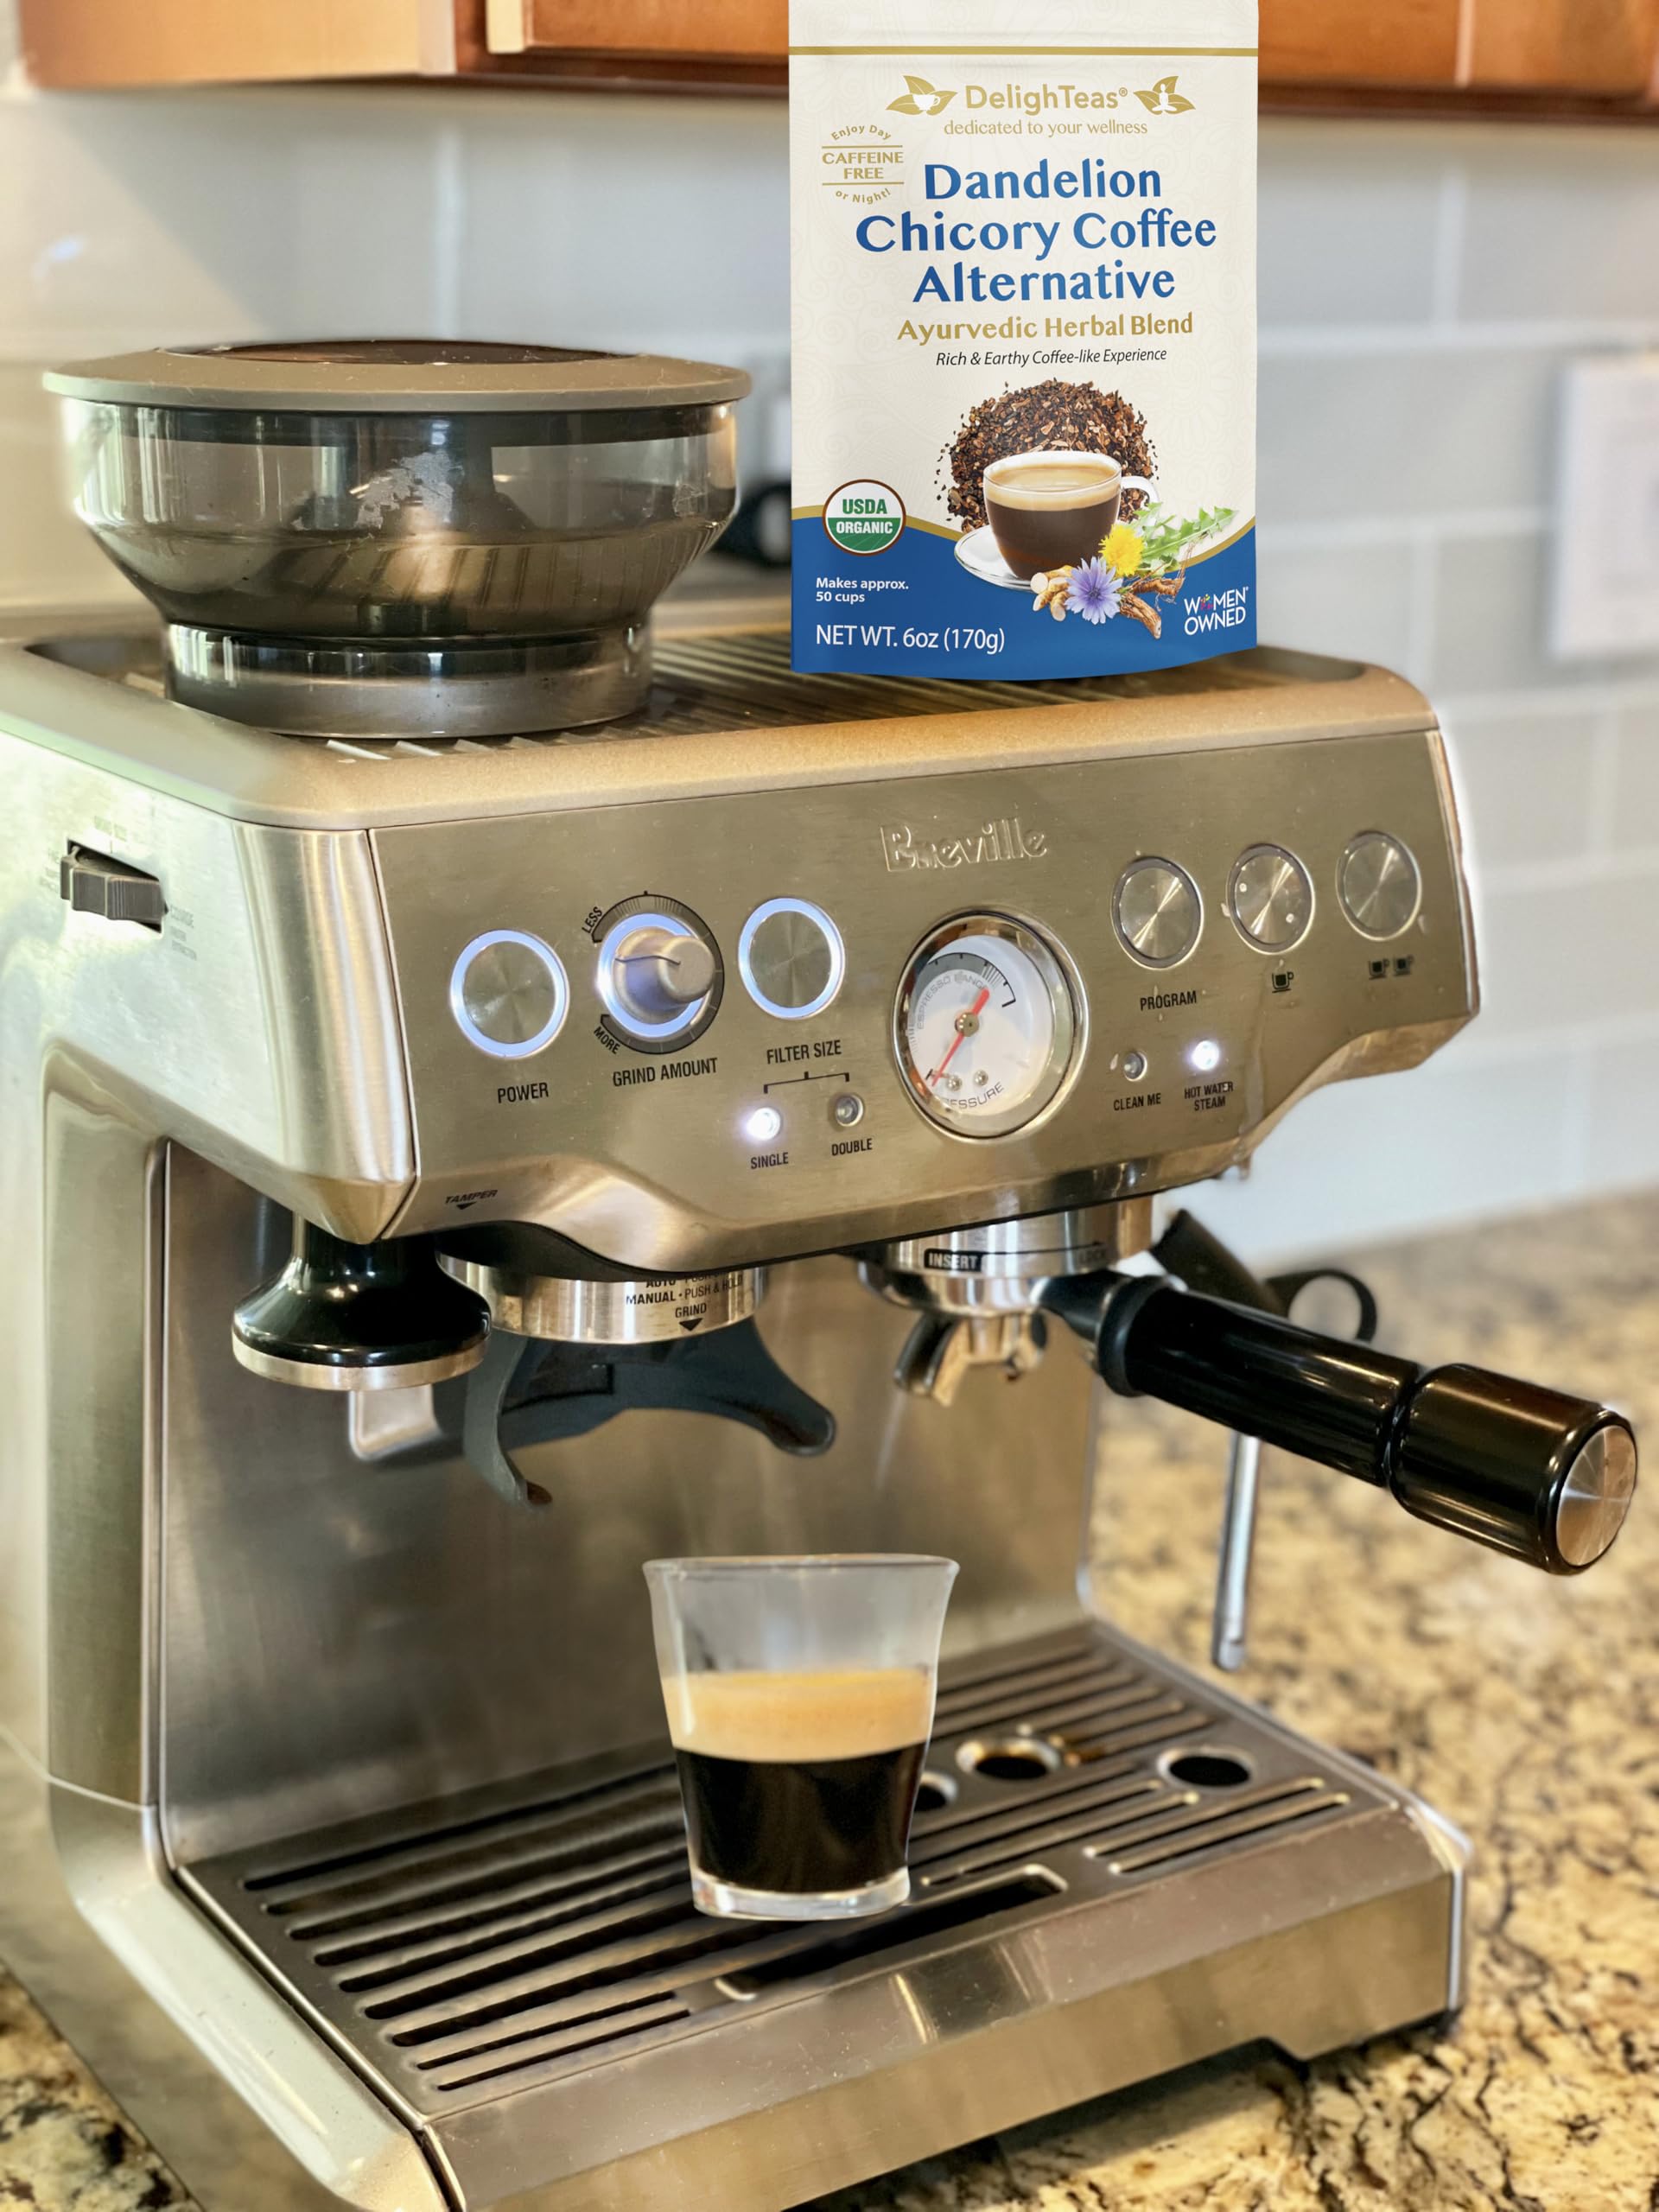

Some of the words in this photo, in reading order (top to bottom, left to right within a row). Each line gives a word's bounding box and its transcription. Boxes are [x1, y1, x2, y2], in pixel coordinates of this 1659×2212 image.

[831, 125, 865, 140] Enjoy
[869, 124, 892, 140] Day
[944, 119, 1022, 135] dedicated
[1027, 122, 1043, 135] to
[1047, 124, 1083, 138] your
[1087, 119, 1147, 135] wellness
[822, 152, 904, 164] CAFFEINE
[843, 168, 884, 180] FREE
[925, 158, 1161, 200] Dandelion
[836, 190, 849, 200] or
[852, 188, 891, 205] Night!
[855, 211, 1058, 261] Chicory
[1073, 207, 1217, 250] Coffee
[912, 259, 1175, 302] Alternative
[897, 316, 1037, 346] Ayurvedic
[1046, 315, 1124, 338] Herbal
[1131, 312, 1193, 335] Blend
[937, 351, 967, 366] Rich
[970, 352, 982, 365] &
[984, 350, 1030, 368] Earthy
[1033, 348, 1100, 365] Coffee-like
[1103, 347, 1166, 365] Experience
[842, 499, 887, 514] USDA
[836, 521, 893, 534] ORGANIC
[816, 577, 857, 589] Makes
[861, 579, 909, 591] approx.
[816, 591, 832, 601] 50
[835, 594, 865, 605] cups
[1185, 606, 1246, 635] OWNED
[817, 625, 857, 645] NET
[861, 626, 898, 646] WT.
[903, 627, 938, 648] 6oz
[944, 627, 1005, 655] (170g)
[880, 818, 1047, 872] Breville
[582, 906, 603, 934] LESS
[1140, 990, 1197, 1011] PROGRAM
[594, 1026, 620, 1055] MORE
[767, 1044, 809, 1065] FILTER
[813, 1040, 842, 1058] SIZE
[613, 1065, 655, 1087] GRIND
[660, 1058, 717, 1082] AMOUNT
[498, 1082, 549, 1104] POWER
[1185, 1085, 1201, 1099] HOT
[1204, 1081, 1233, 1095] WATER
[1113, 1095, 1144, 1111] CLEAN
[1147, 1092, 1161, 1106] ME
[1194, 1096, 1225, 1111] STEAM
[831, 1138, 872, 1156] DOUBLE
[750, 1152, 789, 1170] SINGLE
[445, 1189, 498, 1204] TAMPER
[929, 1253, 978, 1269] INSERT
[626, 1290, 677, 1305] MANUAL
[684, 1285, 711, 1300] PUSH
[713, 1282, 720, 1294] &
[675, 1302, 707, 1319] GRIND
